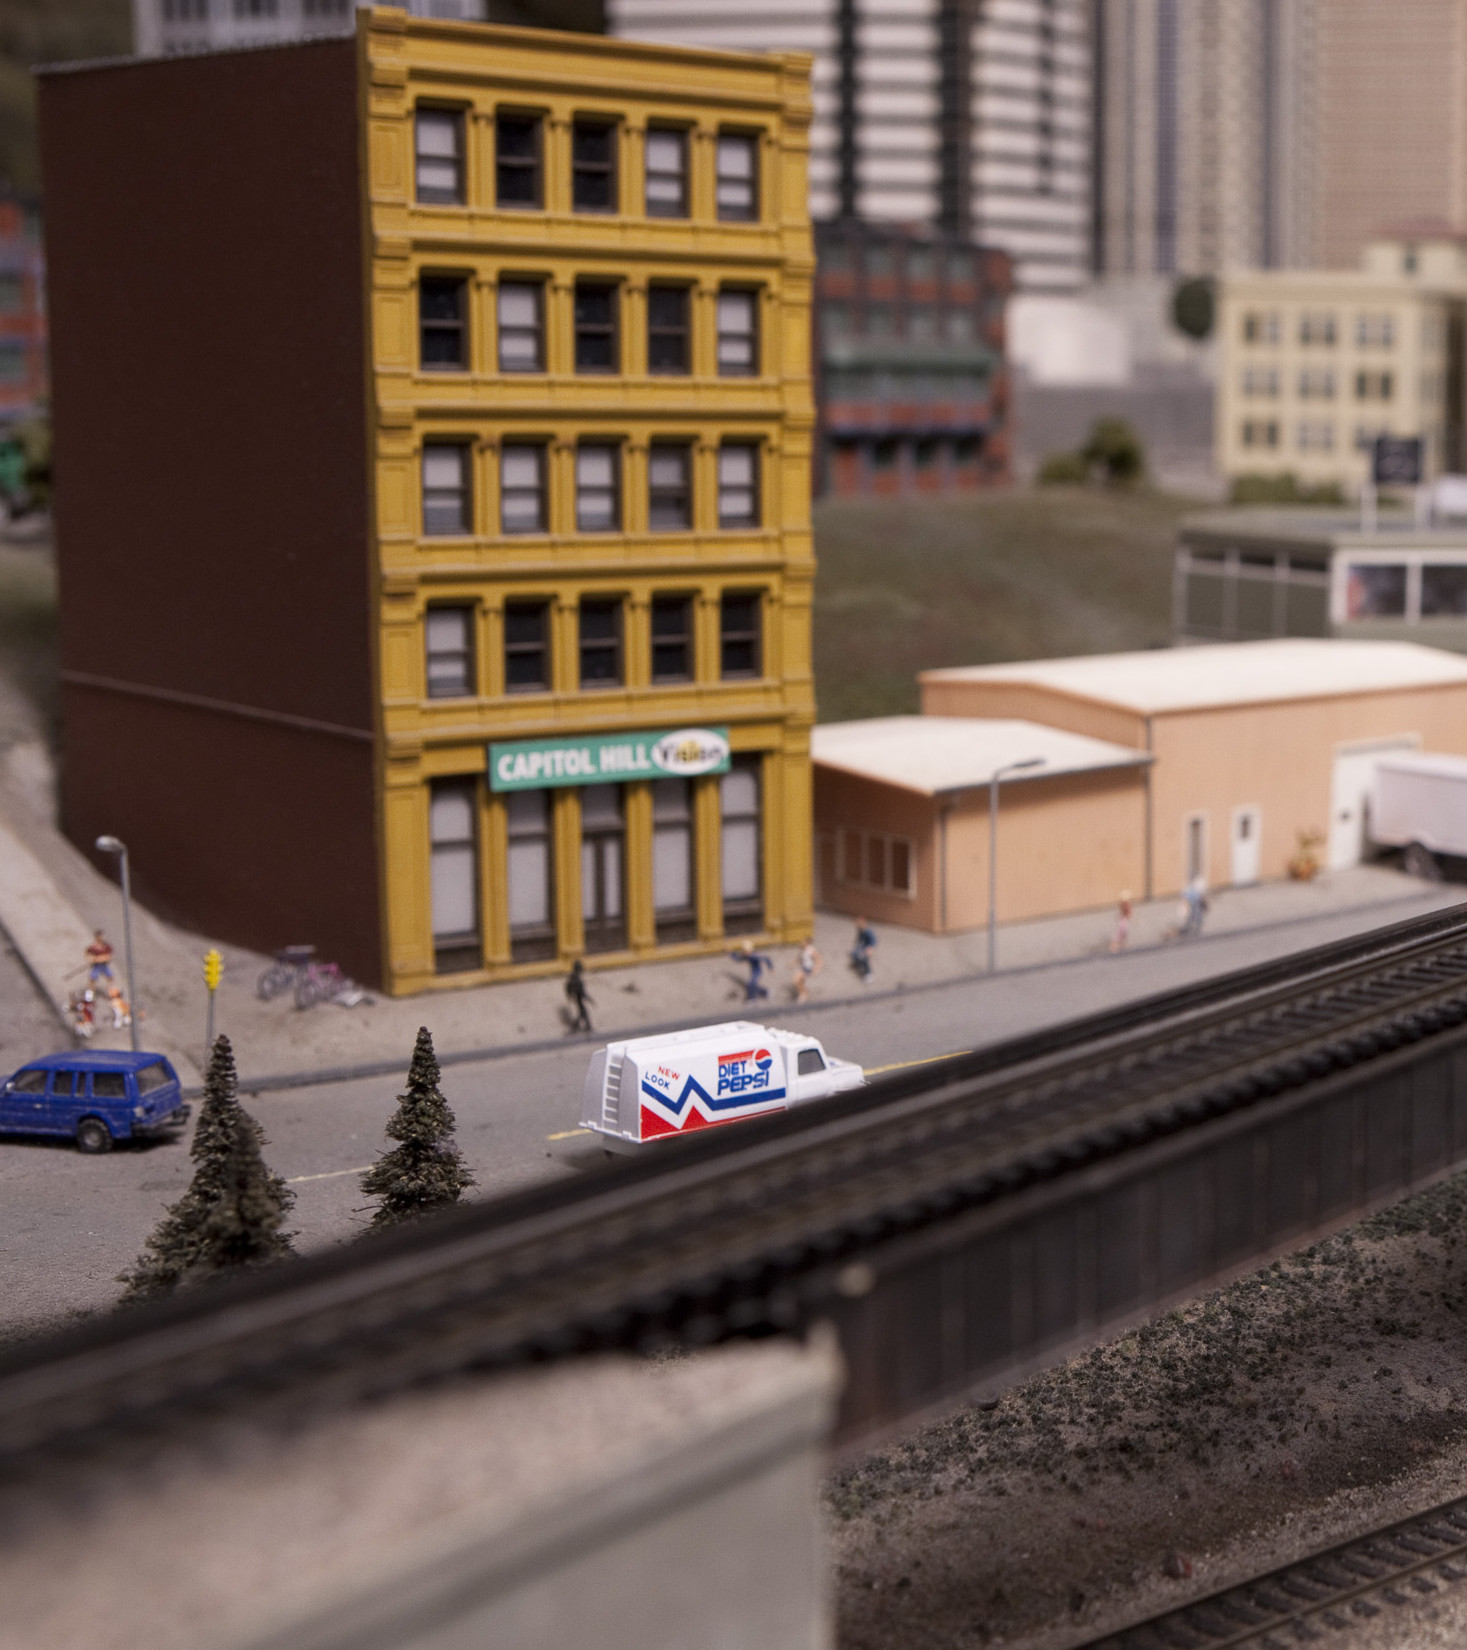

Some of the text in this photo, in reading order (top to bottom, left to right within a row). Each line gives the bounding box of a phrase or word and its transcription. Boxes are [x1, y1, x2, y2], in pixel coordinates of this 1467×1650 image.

[497, 747, 597, 781] CAPITOL
[601, 744, 652, 773] HILL
[658, 1066, 681, 1081] NEW
[718, 1060, 748, 1079] DIET
[645, 1071, 671, 1090] LOOK
[717, 1069, 770, 1096] PEPSI
